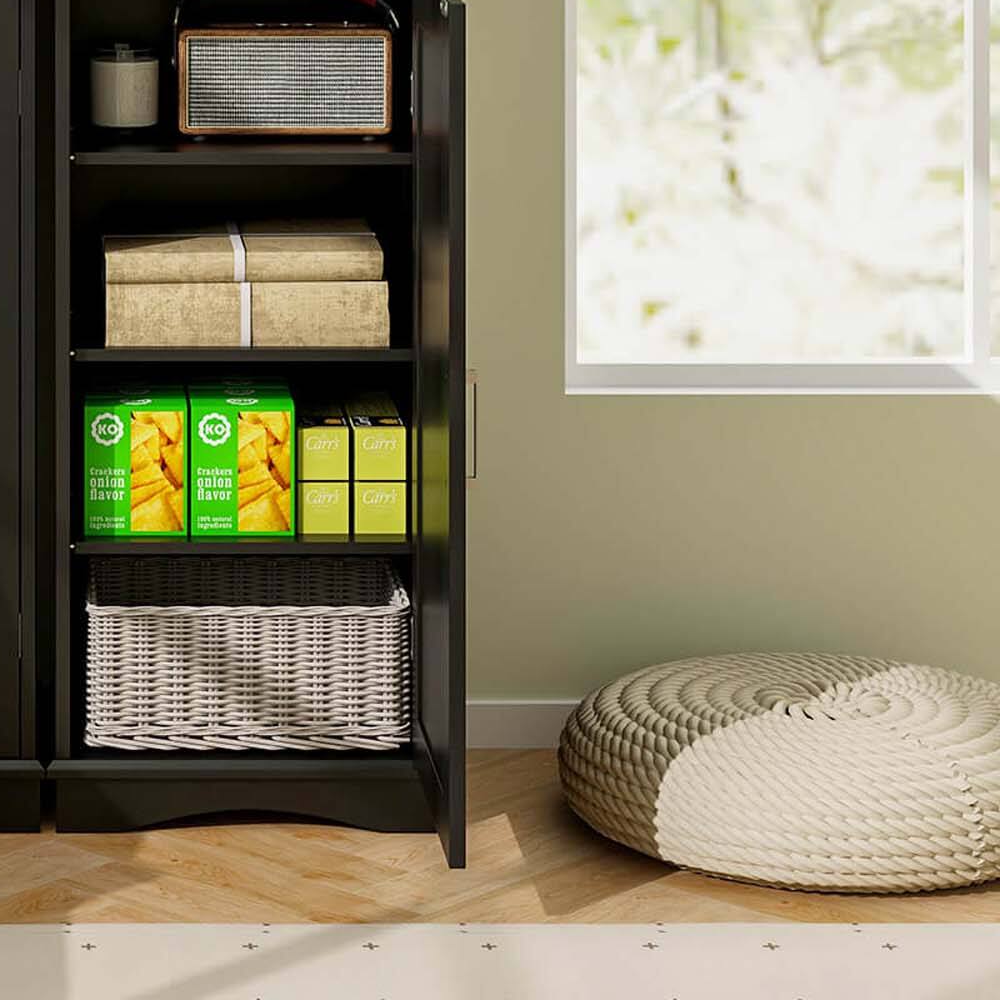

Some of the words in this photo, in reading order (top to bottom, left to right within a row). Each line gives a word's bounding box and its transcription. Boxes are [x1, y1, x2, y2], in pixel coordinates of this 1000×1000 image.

[99, 424, 119, 435] KO
[206, 424, 226, 435] KO
[90, 468, 126, 476] Crackers
[197, 468, 233, 476] Crackers
[90, 476, 126, 488] onion
[197, 476, 233, 488] onion
[90, 489, 126, 501] flavor
[197, 489, 233, 501] flavor
